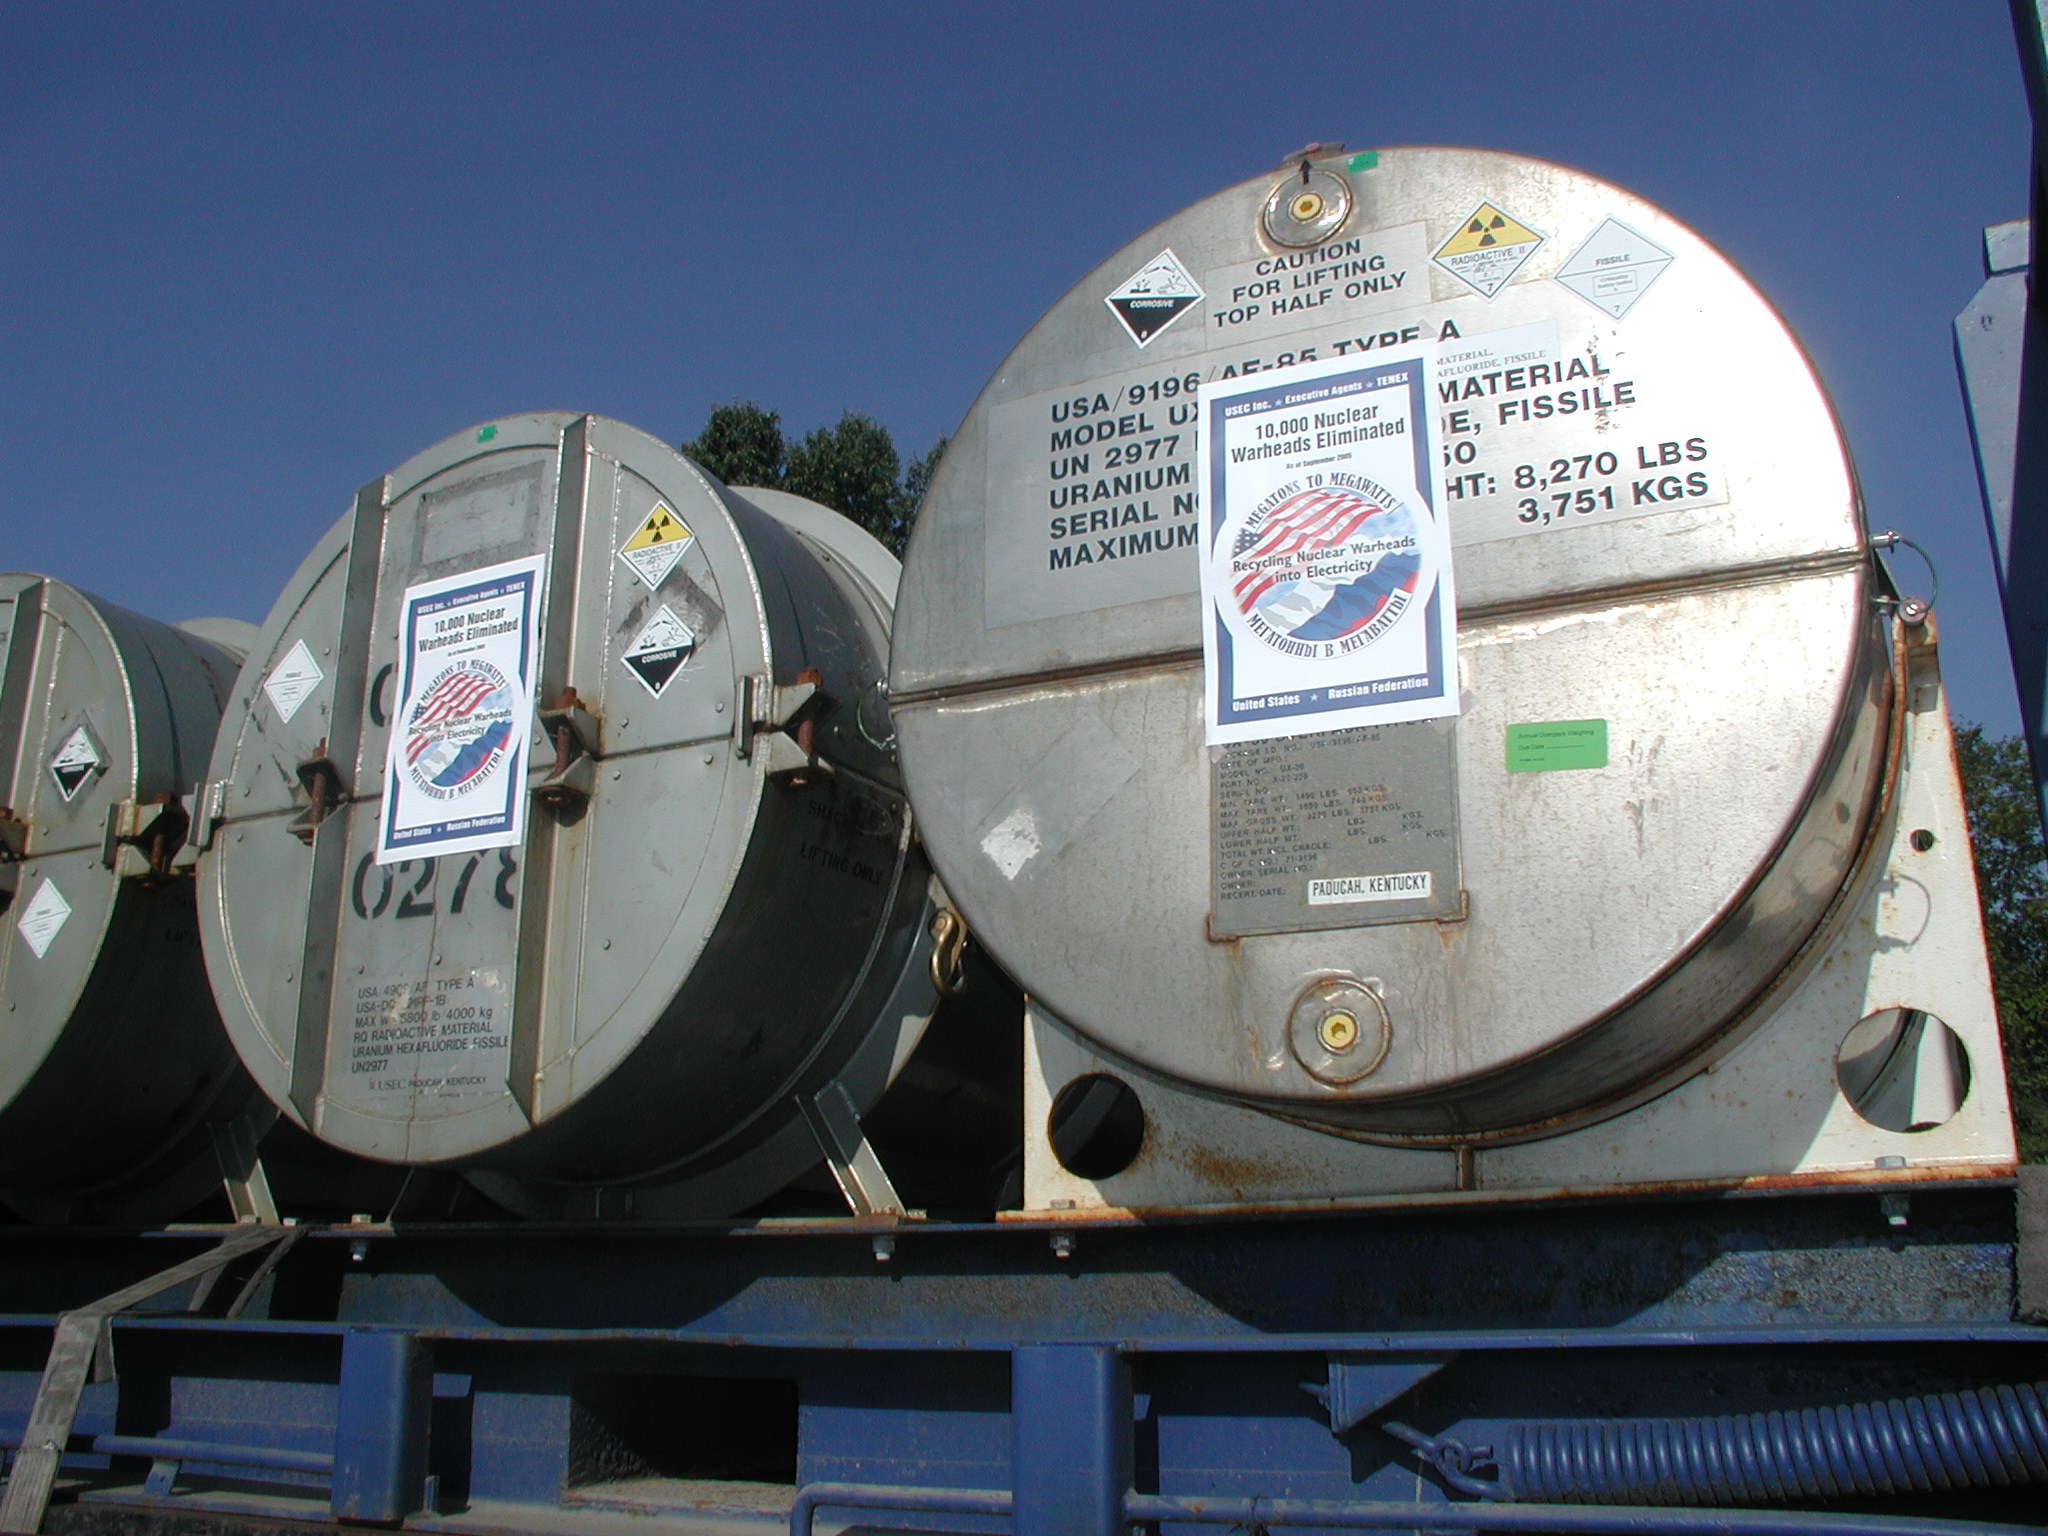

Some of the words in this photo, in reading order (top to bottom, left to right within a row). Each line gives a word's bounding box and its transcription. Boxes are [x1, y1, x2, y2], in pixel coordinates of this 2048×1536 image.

[1256, 239, 1361, 276] CAUTION
[1451, 248, 1513, 266] RADIOACTIVE
[1596, 254, 1631, 266] FISSILE
[1233, 279, 1280, 302] FOR
[1293, 255, 1385, 290] LIFTING
[1487, 283, 1493, 291] 7
[1130, 299, 1174, 309] CORROSIVE
[1214, 305, 1259, 327] TOP
[1272, 289, 1333, 315] HALF
[1345, 271, 1407, 299] ONLY
[1437, 319, 1461, 342] A
[1504, 349, 1547, 366] FISSILE
[1225, 403, 1250, 417] USEC
[1252, 400, 1271, 412] Inc.
[1285, 388, 1329, 405] Executive
[1331, 382, 1363, 396] Agents
[1376, 371, 1409, 387] TENEX
[1438, 354, 1610, 404] MATERIAL
[1498, 381, 1636, 425] FISSILE
[1051, 412, 1154, 452] MODEL
[1255, 416, 1308, 440] 10,000
[1314, 405, 1379, 430] Nuclear
[1050, 453, 1089, 480] UN
[1105, 435, 1180, 470] 2977
[1231, 436, 1311, 464] Warheads
[1316, 417, 1405, 449] Eliminated
[1050, 463, 1190, 510] URANIUM
[1245, 480, 1301, 529] MEGATONS
[1306, 473, 1323, 489] TO
[1329, 472, 1397, 509] MEGAWATTS
[1517, 486, 1615, 525] 3,751
[1631, 472, 1708, 506] KGS
[1049, 523, 1198, 571] MAXIMUM
[1514, 451, 1618, 491] 8,270
[1637, 438, 1707, 470] LBS
[1050, 501, 1158, 539] SERIAL
[1233, 555, 1293, 573] Recycling
[1297, 548, 1346, 563] Nuclear
[1350, 536, 1416, 555] Warheads
[1275, 570, 1301, 583] into
[1306, 559, 1374, 579] Electricity
[418, 629, 464, 652] Warheads
[466, 617, 519, 641] Eliminated
[434, 614, 465, 635] 10,000
[467, 607, 505, 626] Nuclear
[641, 649, 677, 664] CORROSIVE
[420, 664, 454, 702] MEGATONS
[456, 660, 467, 671] TO
[470, 659, 505, 688] MEGAWATTS
[1232, 697, 1265, 712] United
[1267, 693, 1300, 707] States
[1328, 684, 1369, 700] Russian
[1372, 677, 1429, 694] Federation
[408, 721, 441, 736] Recycling
[444, 716, 472, 728] Nuclear
[474, 708, 512, 721] Warheads
[447, 726, 486, 740] Electricity
[1370, 874, 1426, 892] KENTUCKY
[436, 978, 462, 991] TYPE
[467, 977, 474, 988] A
[355, 1016, 376, 1029] MAX
[480, 1007, 493, 1020] kg
[371, 1025, 437, 1041] RADIOACTIVE
[442, 1021, 493, 1036] MATERIAL
[353, 1045, 394, 1058] URANIUM
[397, 1038, 469, 1055] HEXAFLUORIDE
[352, 1059, 388, 1074] UN2977
[446, 1076, 487, 1086] KENTUCKY
